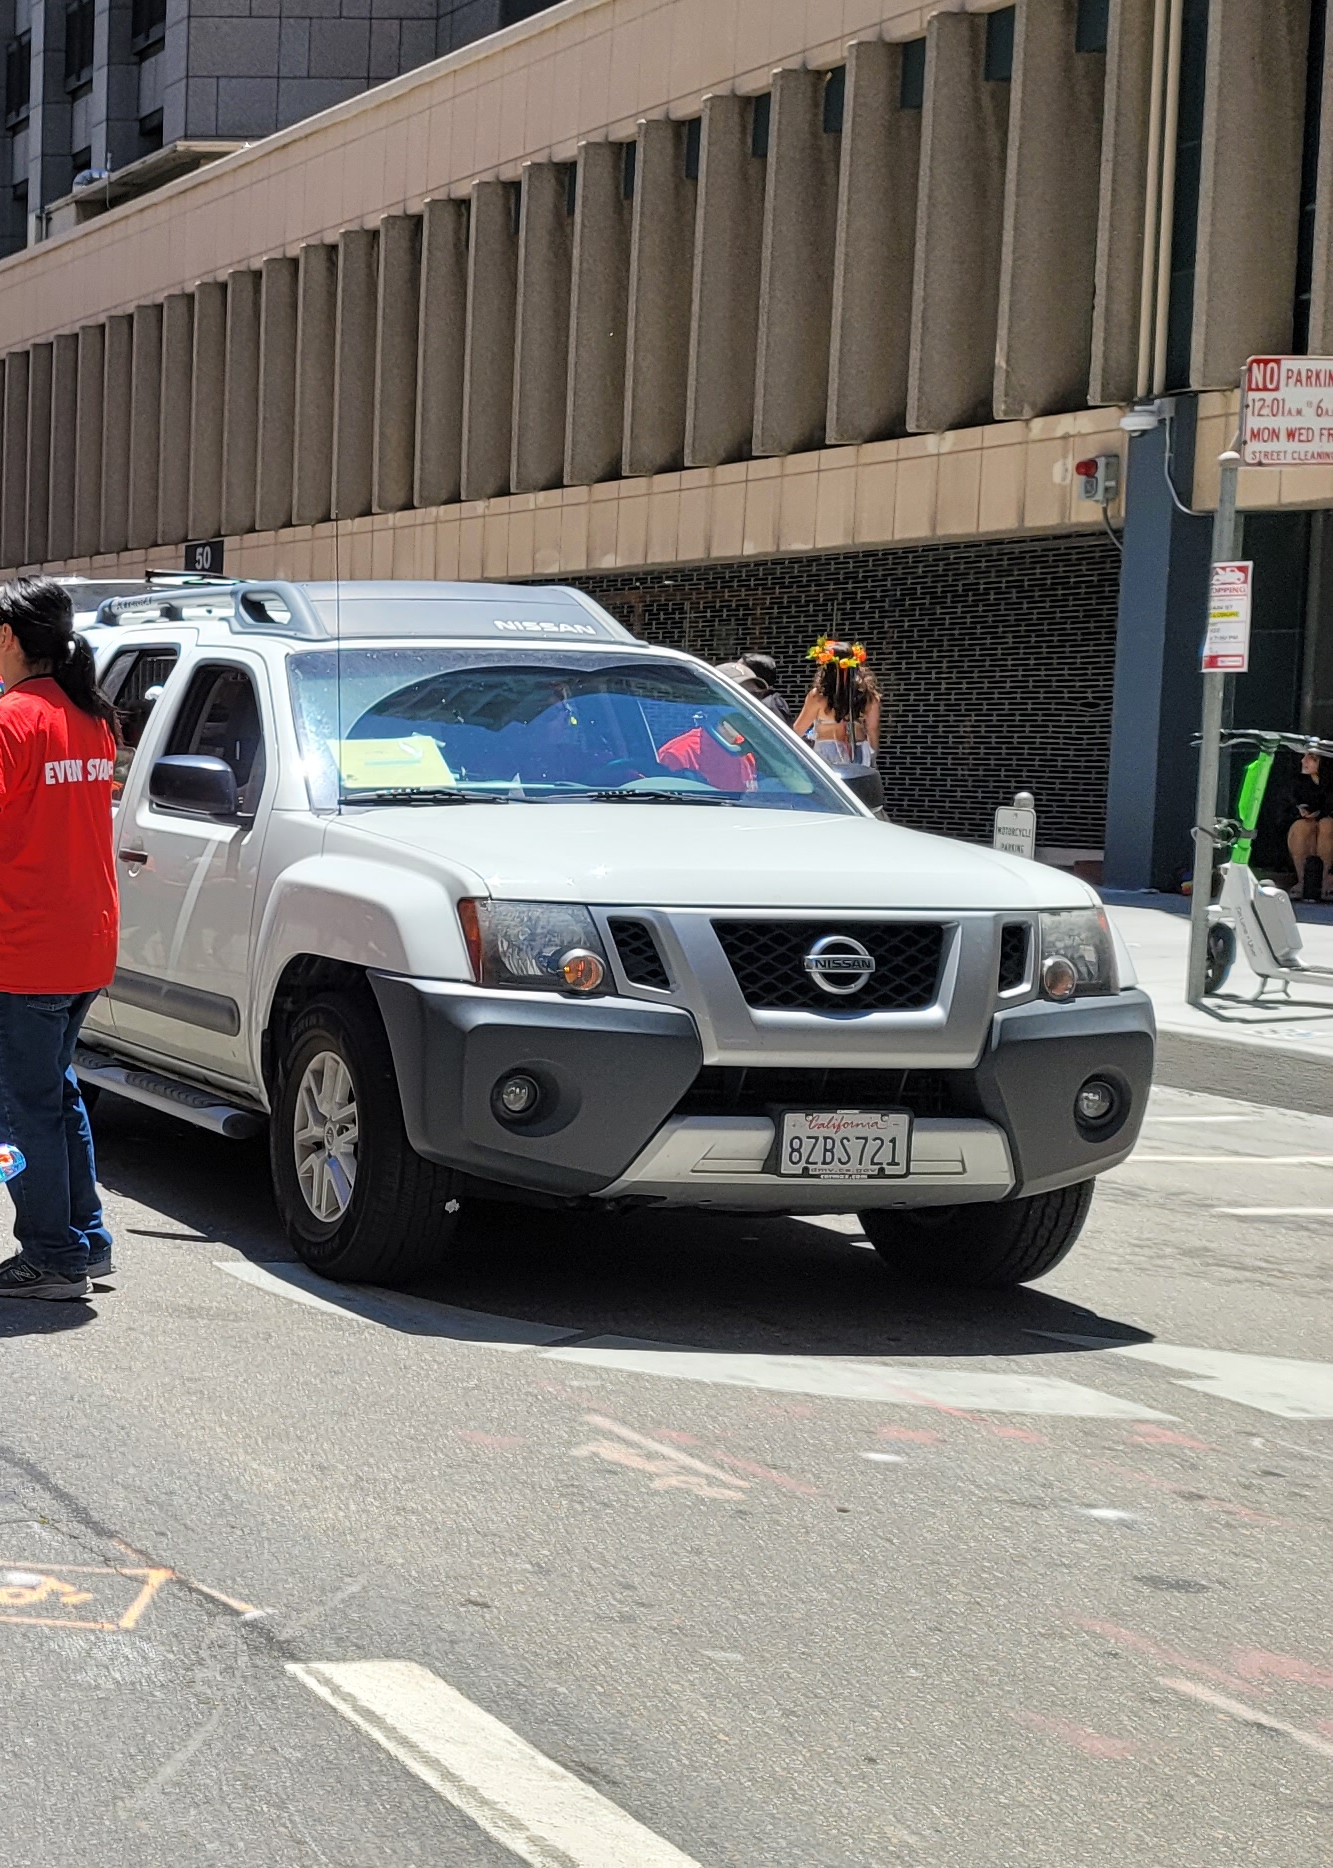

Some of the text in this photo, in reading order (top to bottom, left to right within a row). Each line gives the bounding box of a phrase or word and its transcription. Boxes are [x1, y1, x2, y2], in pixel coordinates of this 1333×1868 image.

[1251, 361, 1279, 390] NO
[1249, 426, 1281, 443] MON
[1285, 427, 1314, 443] WED
[1251, 450, 1288, 461] STREET
[195, 546, 212, 570] 50
[493, 620, 597, 635] NISSAN
[998, 827, 1032, 838] MOTORCYCLE
[814, 959, 872, 970] NISSAN
[807, 1114, 889, 1135] California
[788, 1135, 901, 1167] 8ZBS721
